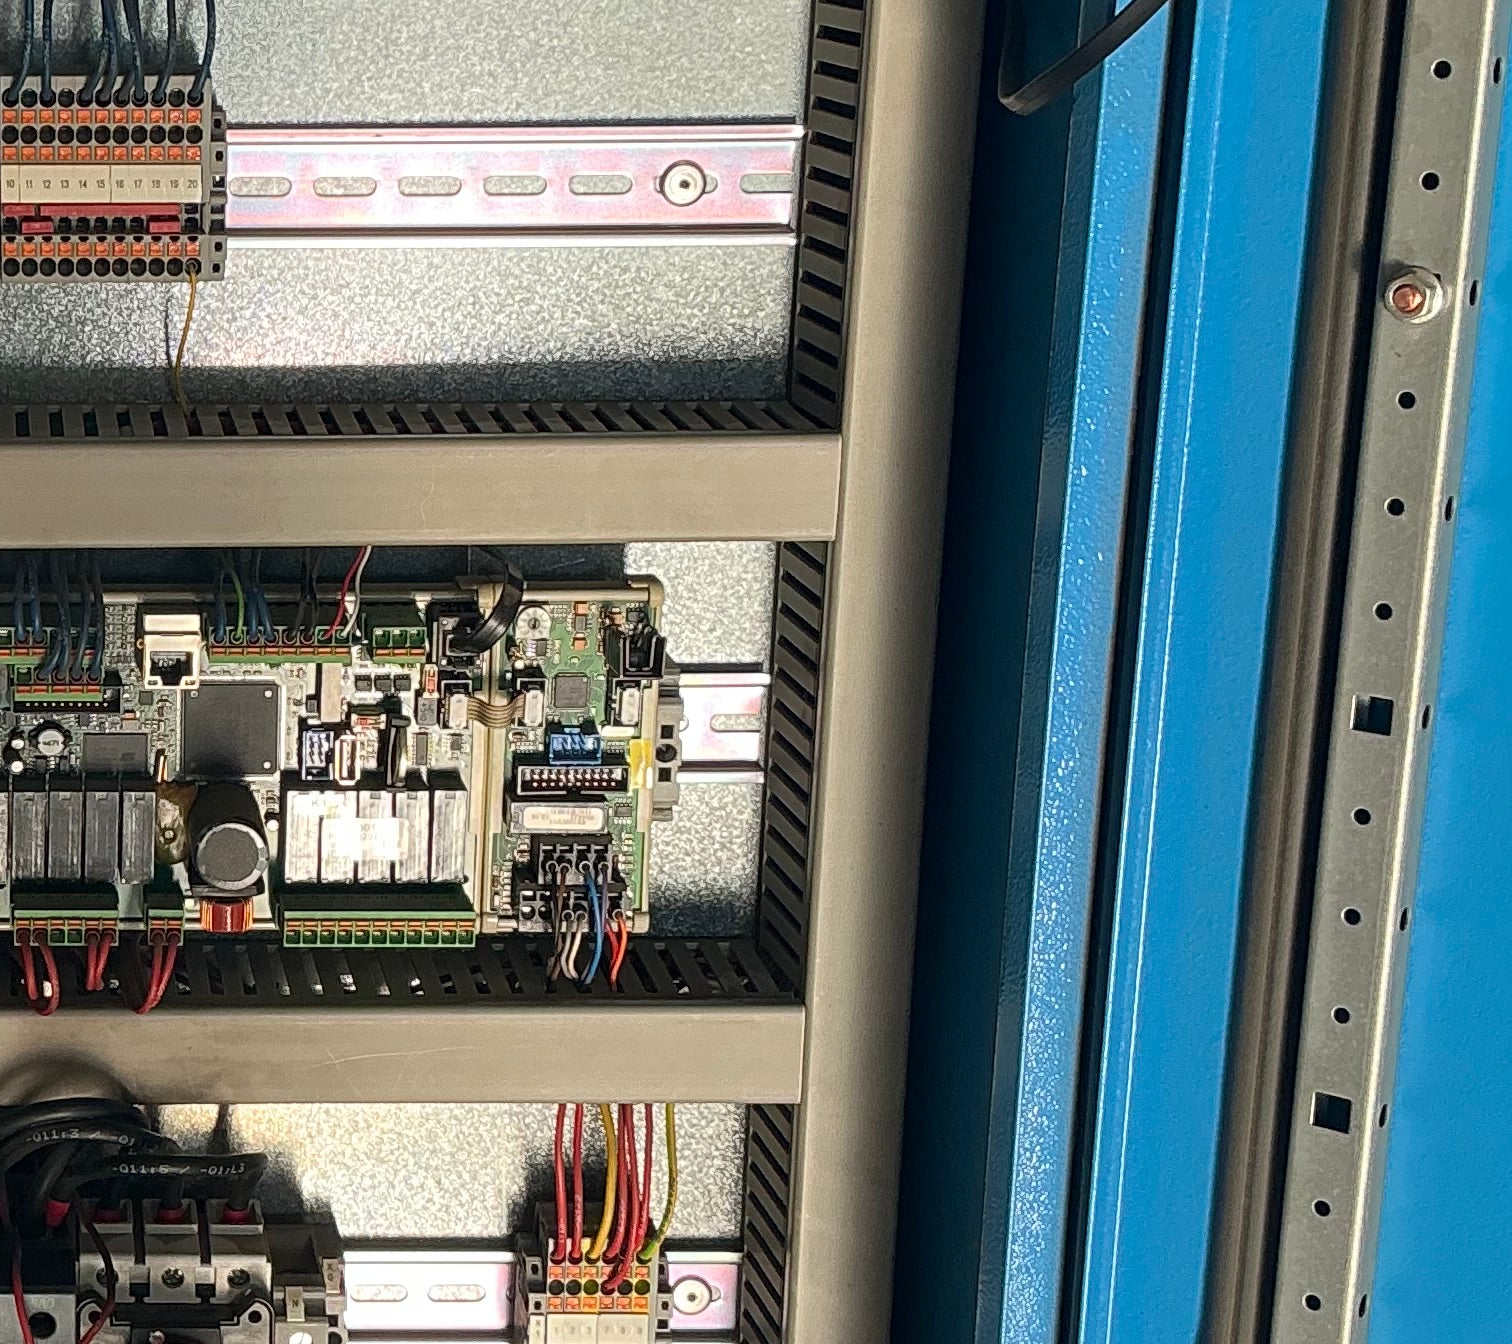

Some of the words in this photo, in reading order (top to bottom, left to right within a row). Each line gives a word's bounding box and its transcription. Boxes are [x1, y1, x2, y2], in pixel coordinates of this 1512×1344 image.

[6, 180, 15, 188] 10
[25, 180, 33, 188] 11
[43, 180, 51, 188] 12
[60, 180, 69, 188] 13
[78, 180, 87, 188] 14
[96, 180, 105, 188] 15
[115, 180, 124, 188] 16
[134, 180, 142, 188] 17
[151, 180, 160, 188] 18
[170, 180, 179, 188] 19
[187, 180, 198, 188] 20
